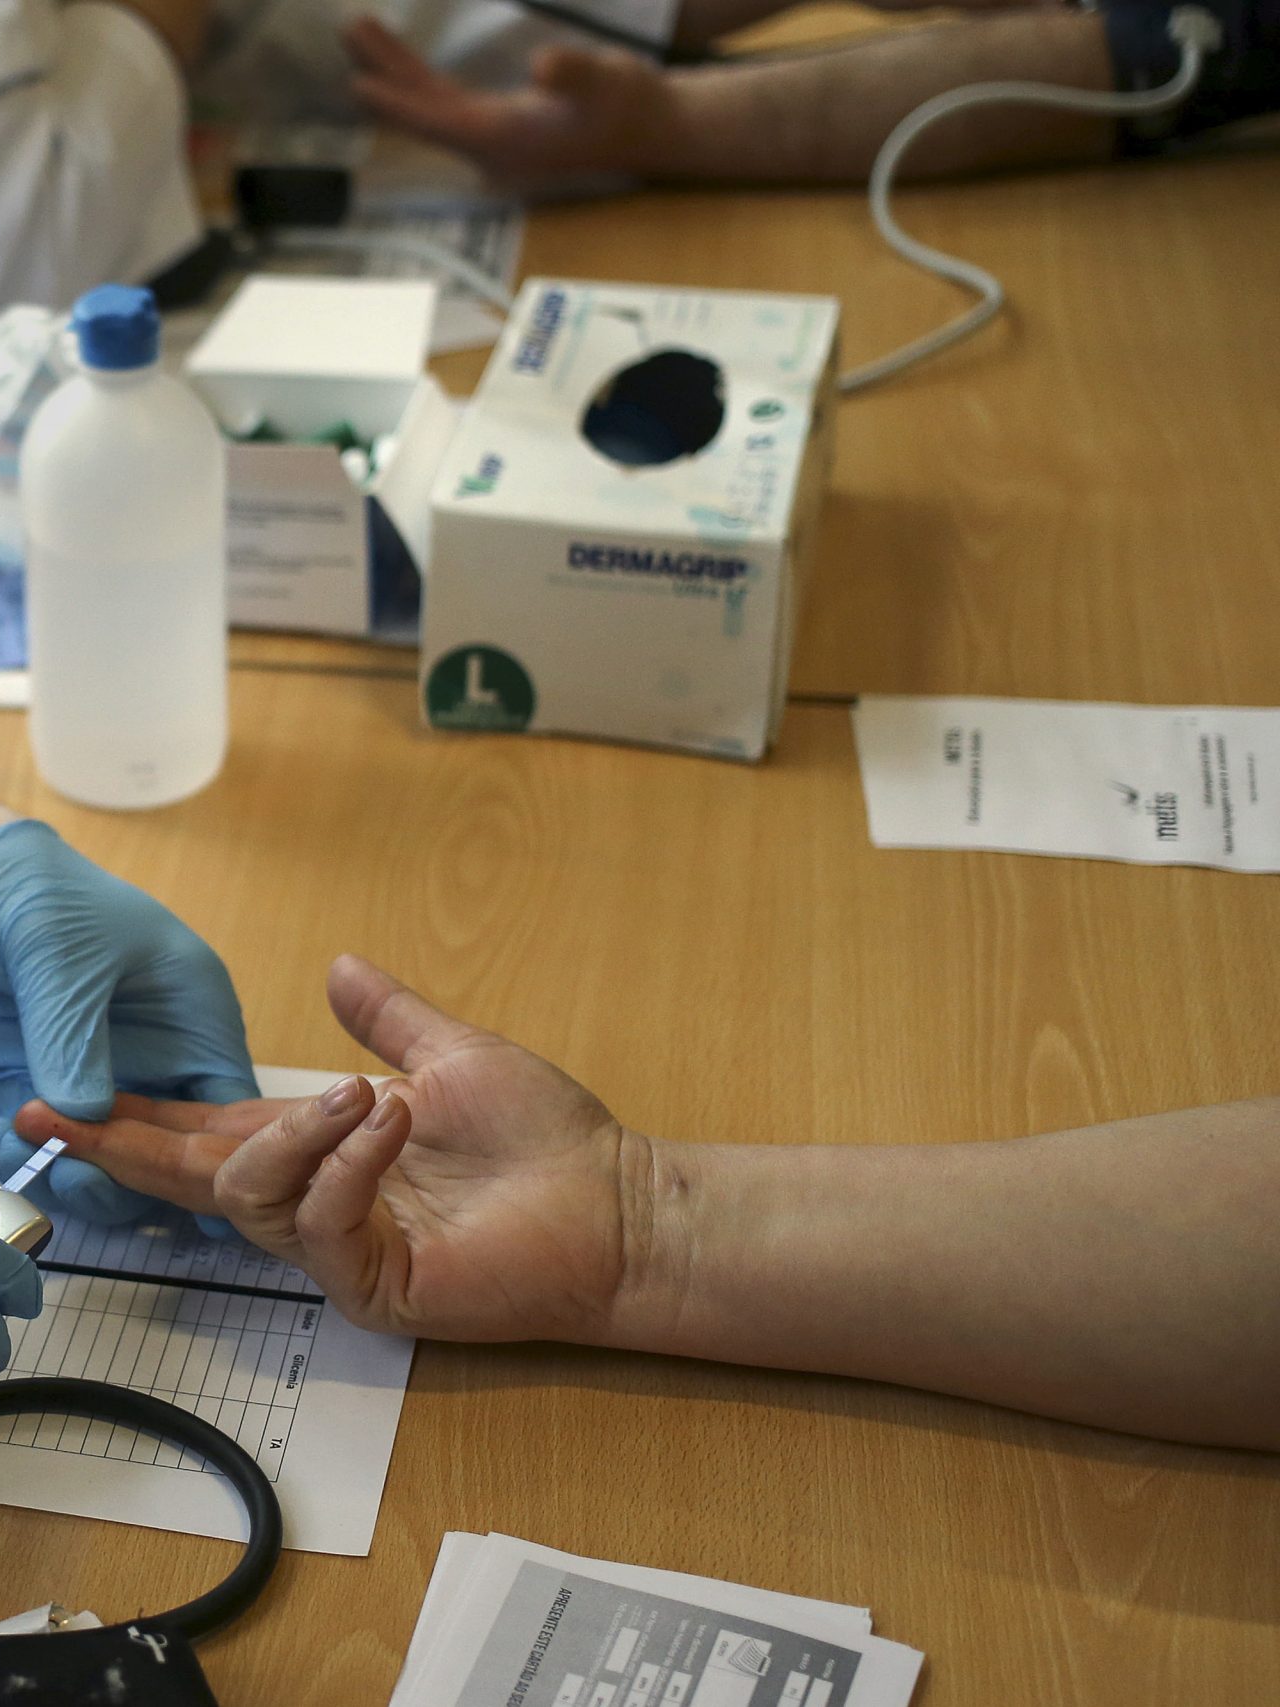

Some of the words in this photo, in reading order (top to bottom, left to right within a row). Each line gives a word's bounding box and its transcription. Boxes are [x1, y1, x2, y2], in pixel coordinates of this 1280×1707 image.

[568, 543, 748, 581] DERMAGRIP
[466, 655, 498, 701] L
[302, 1309, 317, 1330] Idade
[286, 1354, 304, 1390] Glicemia
[270, 1438, 282, 1449] TA
[545, 1588, 572, 1632] APRESENTE
[534, 1631, 553, 1651] ESTE
[520, 1650, 544, 1681] CARTÃO
[513, 1679, 530, 1693] AO
